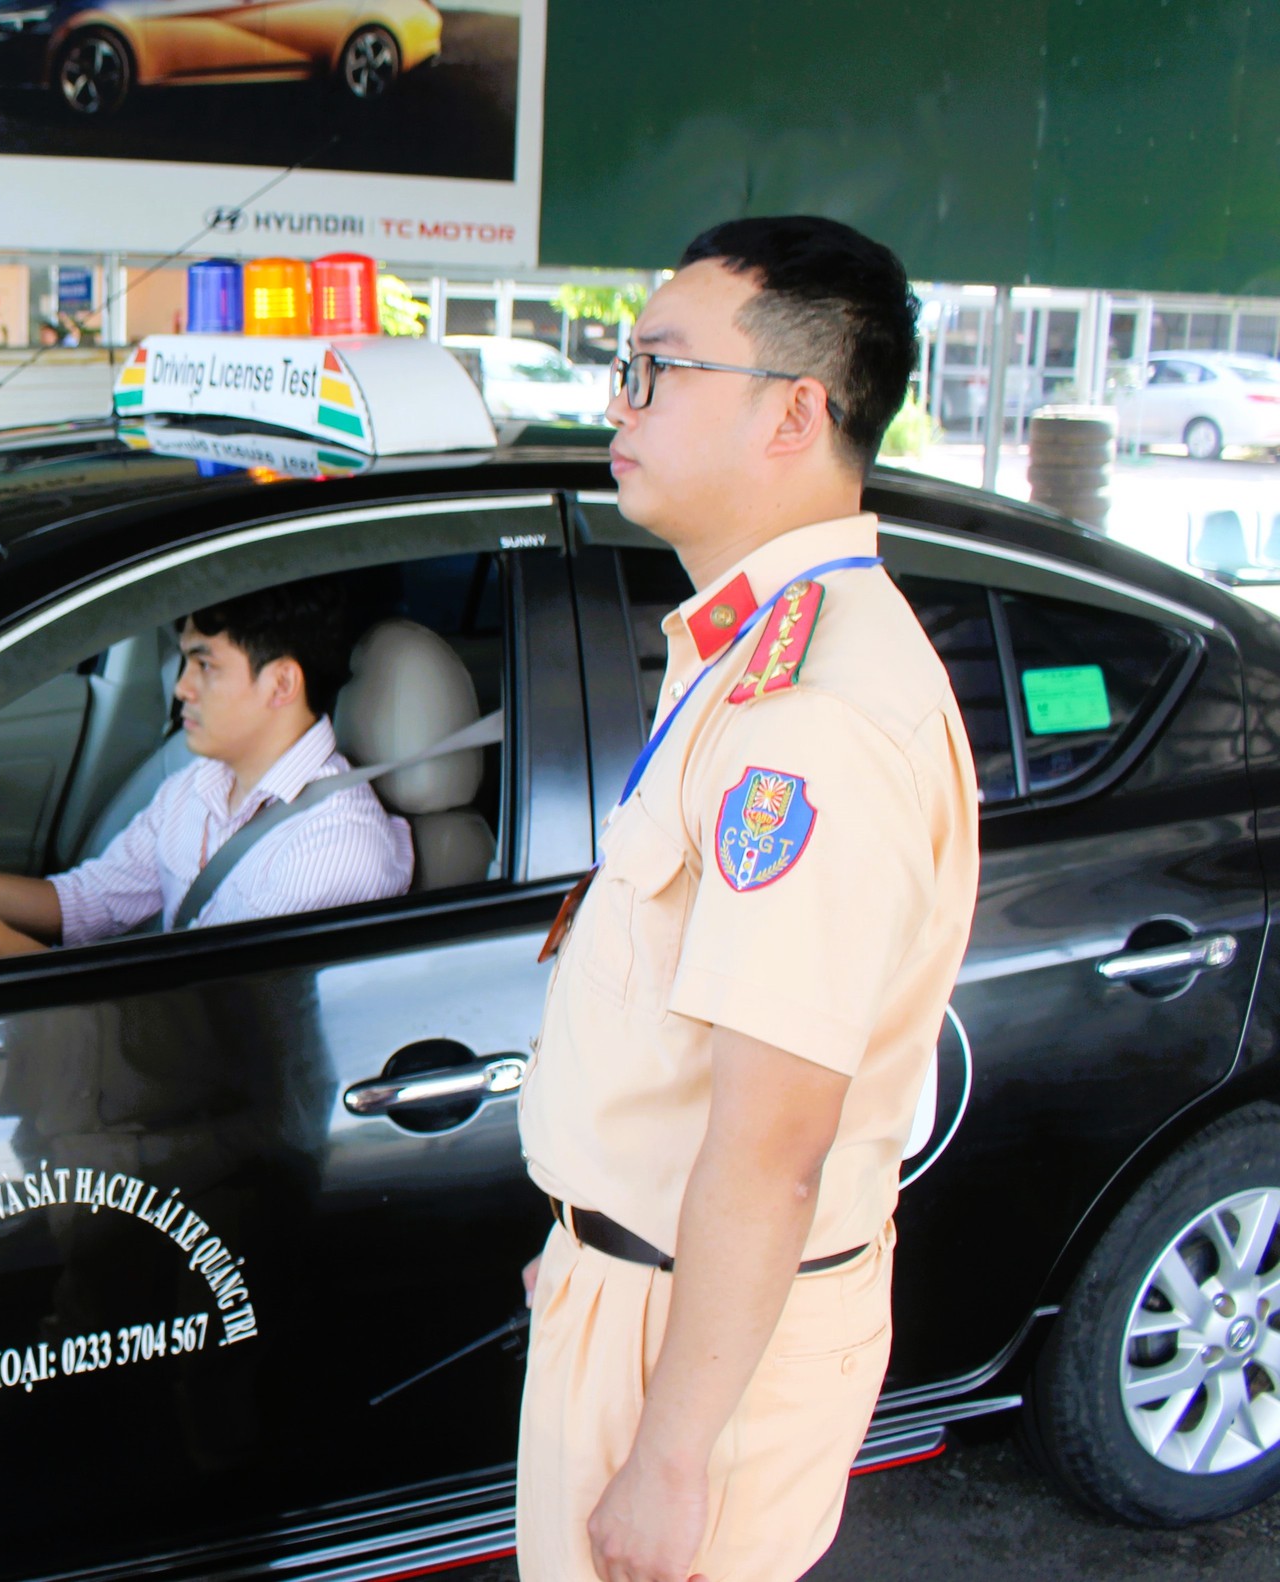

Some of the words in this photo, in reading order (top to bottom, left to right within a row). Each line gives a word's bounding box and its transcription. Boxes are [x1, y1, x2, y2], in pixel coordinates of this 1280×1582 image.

[254, 210, 365, 237] HYUNDAI
[380, 217, 415, 239] TC
[418, 221, 516, 243] MOTOR
[152, 353, 204, 395] Driving
[209, 353, 274, 393] License
[280, 357, 318, 398] Test
[500, 533, 546, 549] SUNNY
[23, 1159, 70, 1208] SÁT
[74, 1167, 145, 1214] HẠCH
[136, 1187, 185, 1233] LÁI
[168, 1210, 210, 1252] XE
[188, 1236, 249, 1310] QUẢNG
[61, 1331, 111, 1376] 0233
[116, 1321, 167, 1366] 3704
[171, 1312, 209, 1355] 567
[218, 1303, 258, 1347] TRỊ
